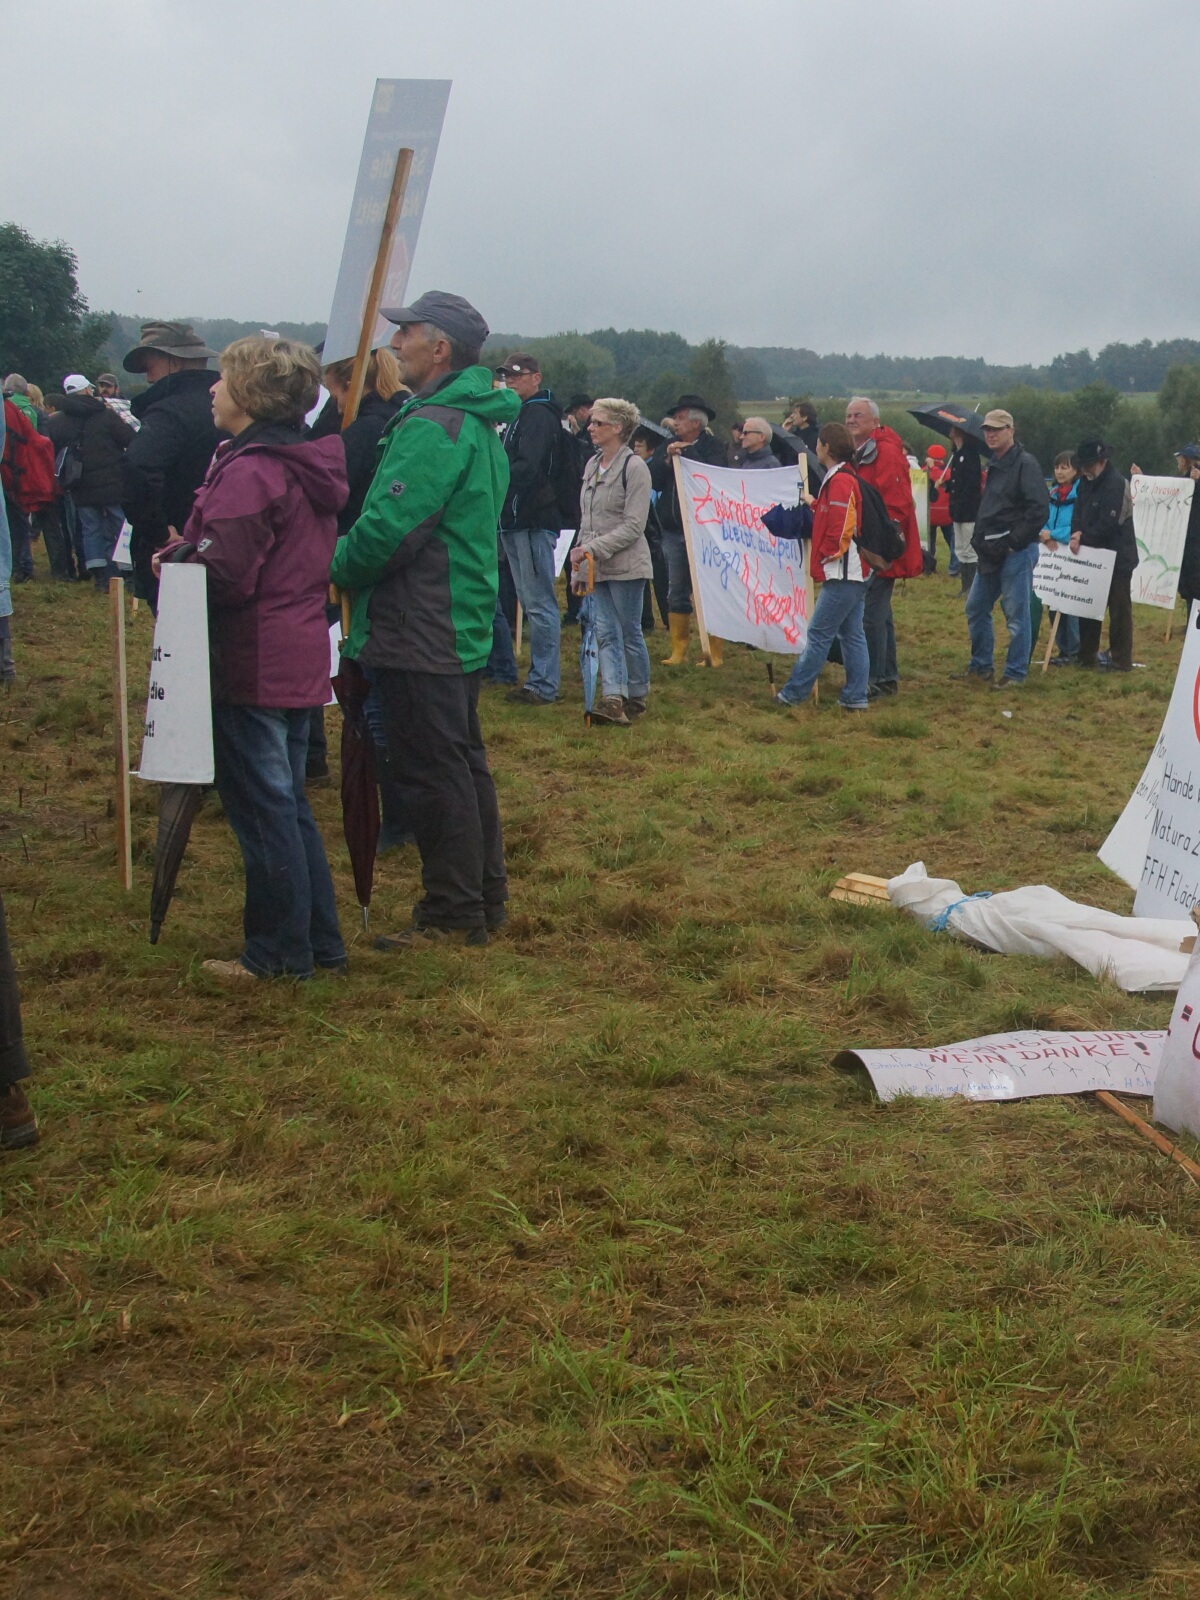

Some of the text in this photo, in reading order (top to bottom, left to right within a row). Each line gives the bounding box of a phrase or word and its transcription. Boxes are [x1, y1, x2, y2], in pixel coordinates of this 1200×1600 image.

[1161, 763, 1195, 801] Hände
[1151, 808, 1192, 851] Natura
[1141, 855, 1169, 893] FFH
[929, 1053, 1008, 1064] NEIN
